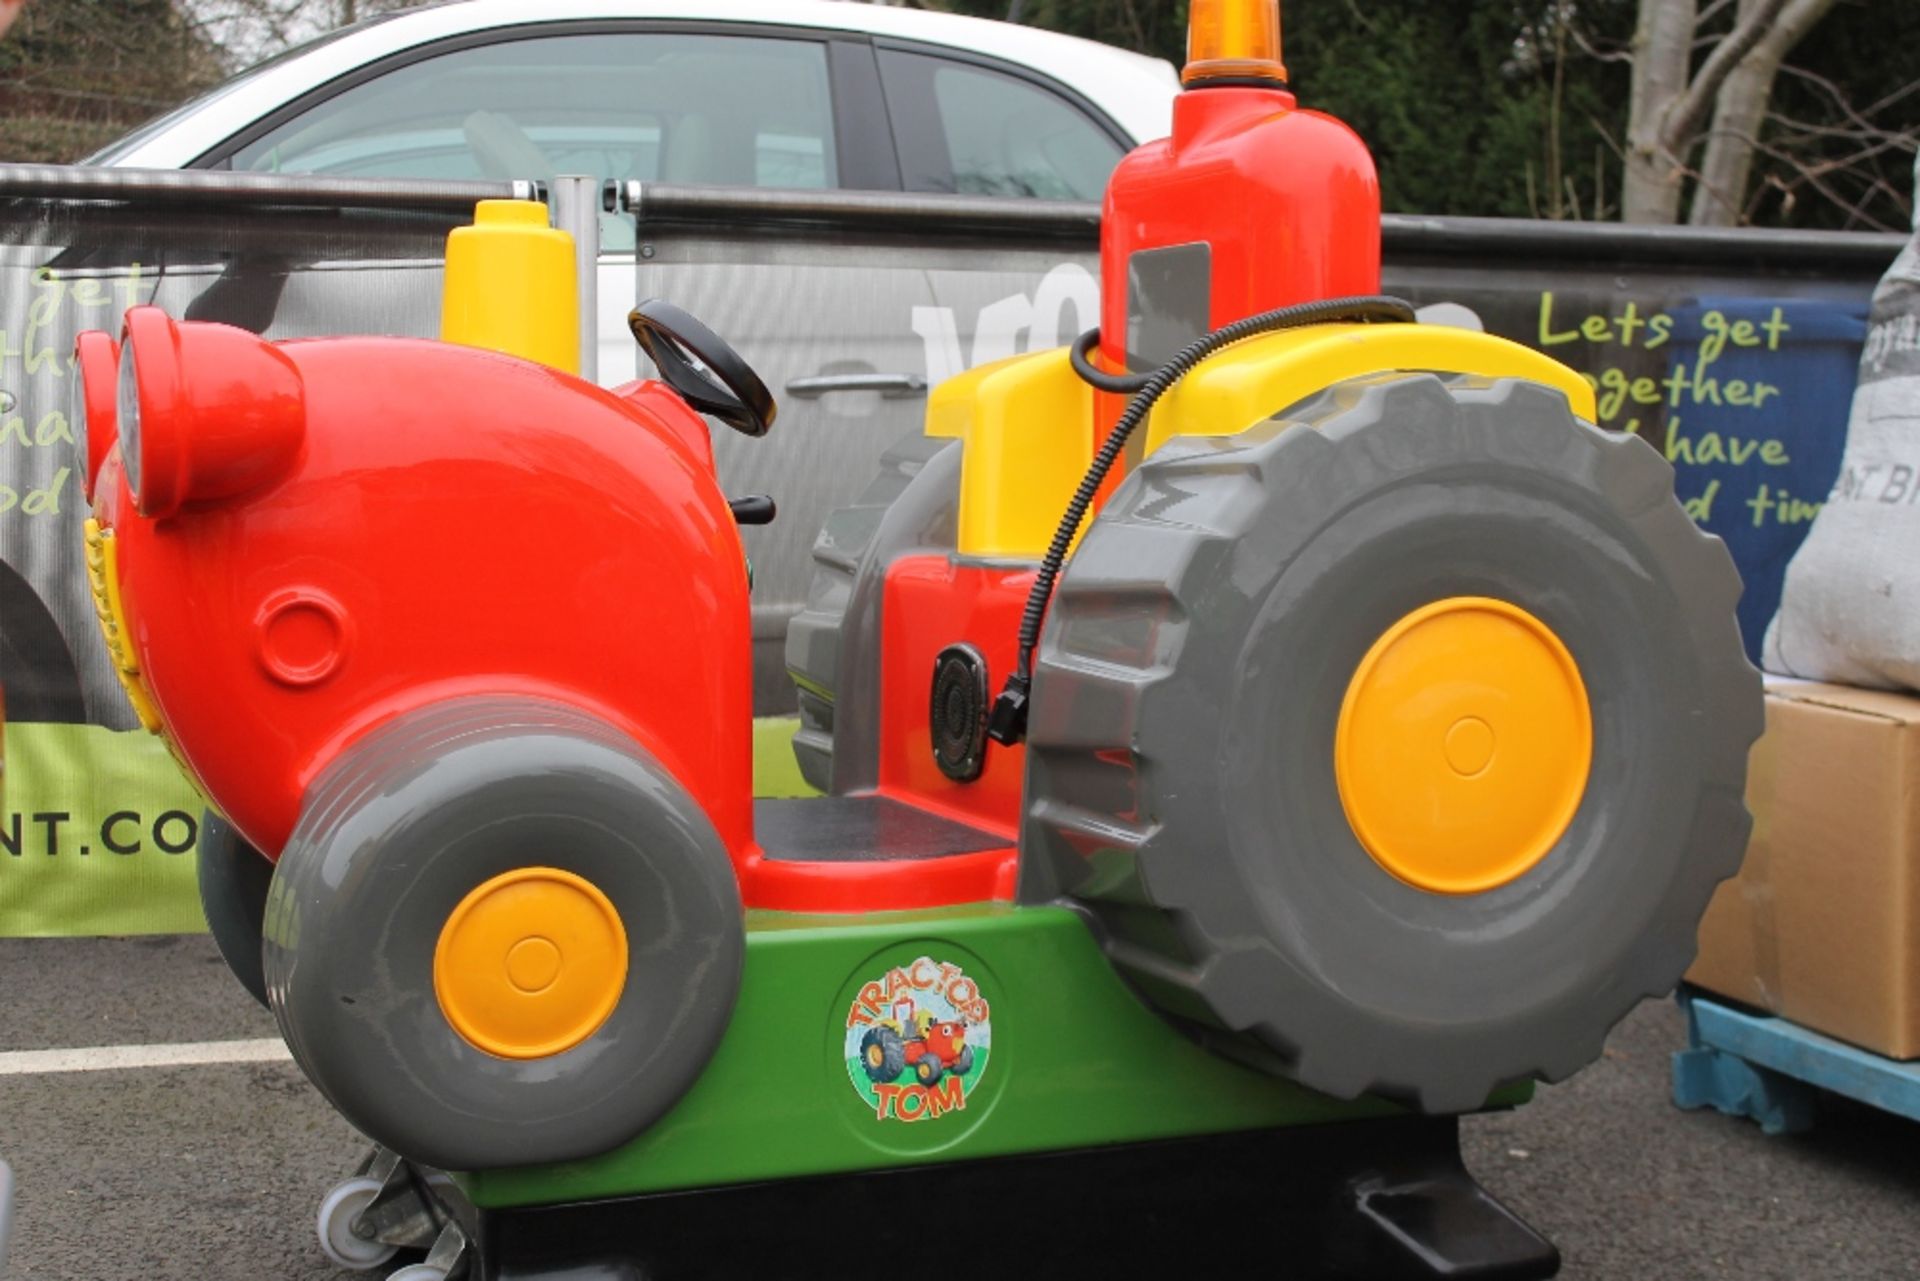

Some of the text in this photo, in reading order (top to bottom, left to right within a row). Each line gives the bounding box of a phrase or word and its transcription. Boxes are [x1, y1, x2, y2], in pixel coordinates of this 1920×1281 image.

[30, 262, 154, 327] get
[1539, 290, 1673, 349] Lets
[1700, 307, 1791, 364] get
[1583, 359, 1781, 422] gether
[1664, 415, 1791, 466] have
[1745, 484, 1824, 528] tim
[847, 956, 990, 1029] TRACTOR
[871, 1074, 967, 1122] TOM
